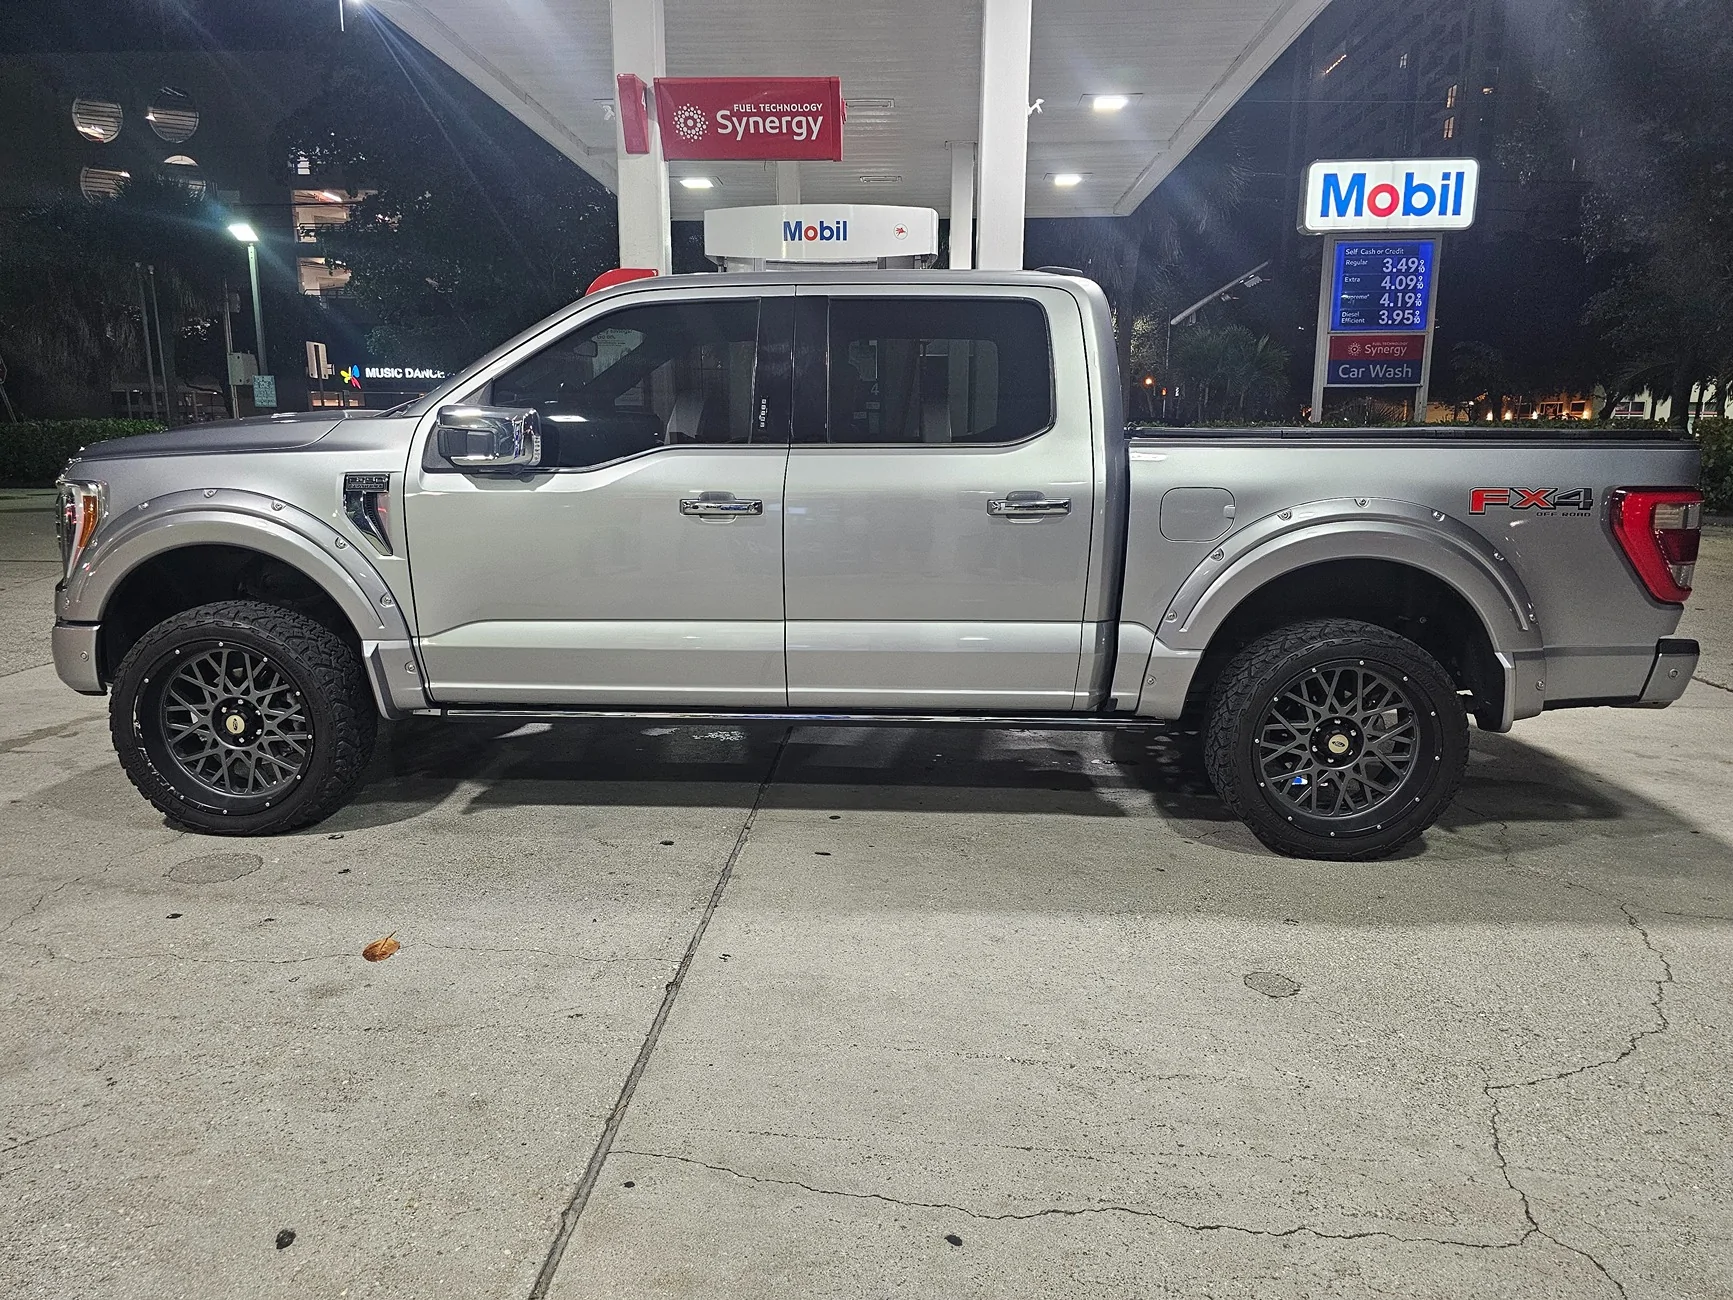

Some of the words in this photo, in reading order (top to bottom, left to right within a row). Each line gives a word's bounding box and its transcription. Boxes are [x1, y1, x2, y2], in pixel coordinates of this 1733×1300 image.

[734, 104, 757, 112] FUEL
[759, 103, 823, 112] TECHNOLOGY
[716, 110, 824, 141] Synergy
[1320, 171, 1465, 217] Mobil
[783, 220, 848, 242] Mobil
[1345, 259, 1368, 267] Regular
[1364, 344, 1408, 357] Synergy
[365, 367, 403, 378] MUSIC
[1338, 364, 1366, 378] Car
[1369, 363, 1412, 378] Wash
[871, 383, 880, 396] 4
[1468, 486, 1594, 515] FX4
